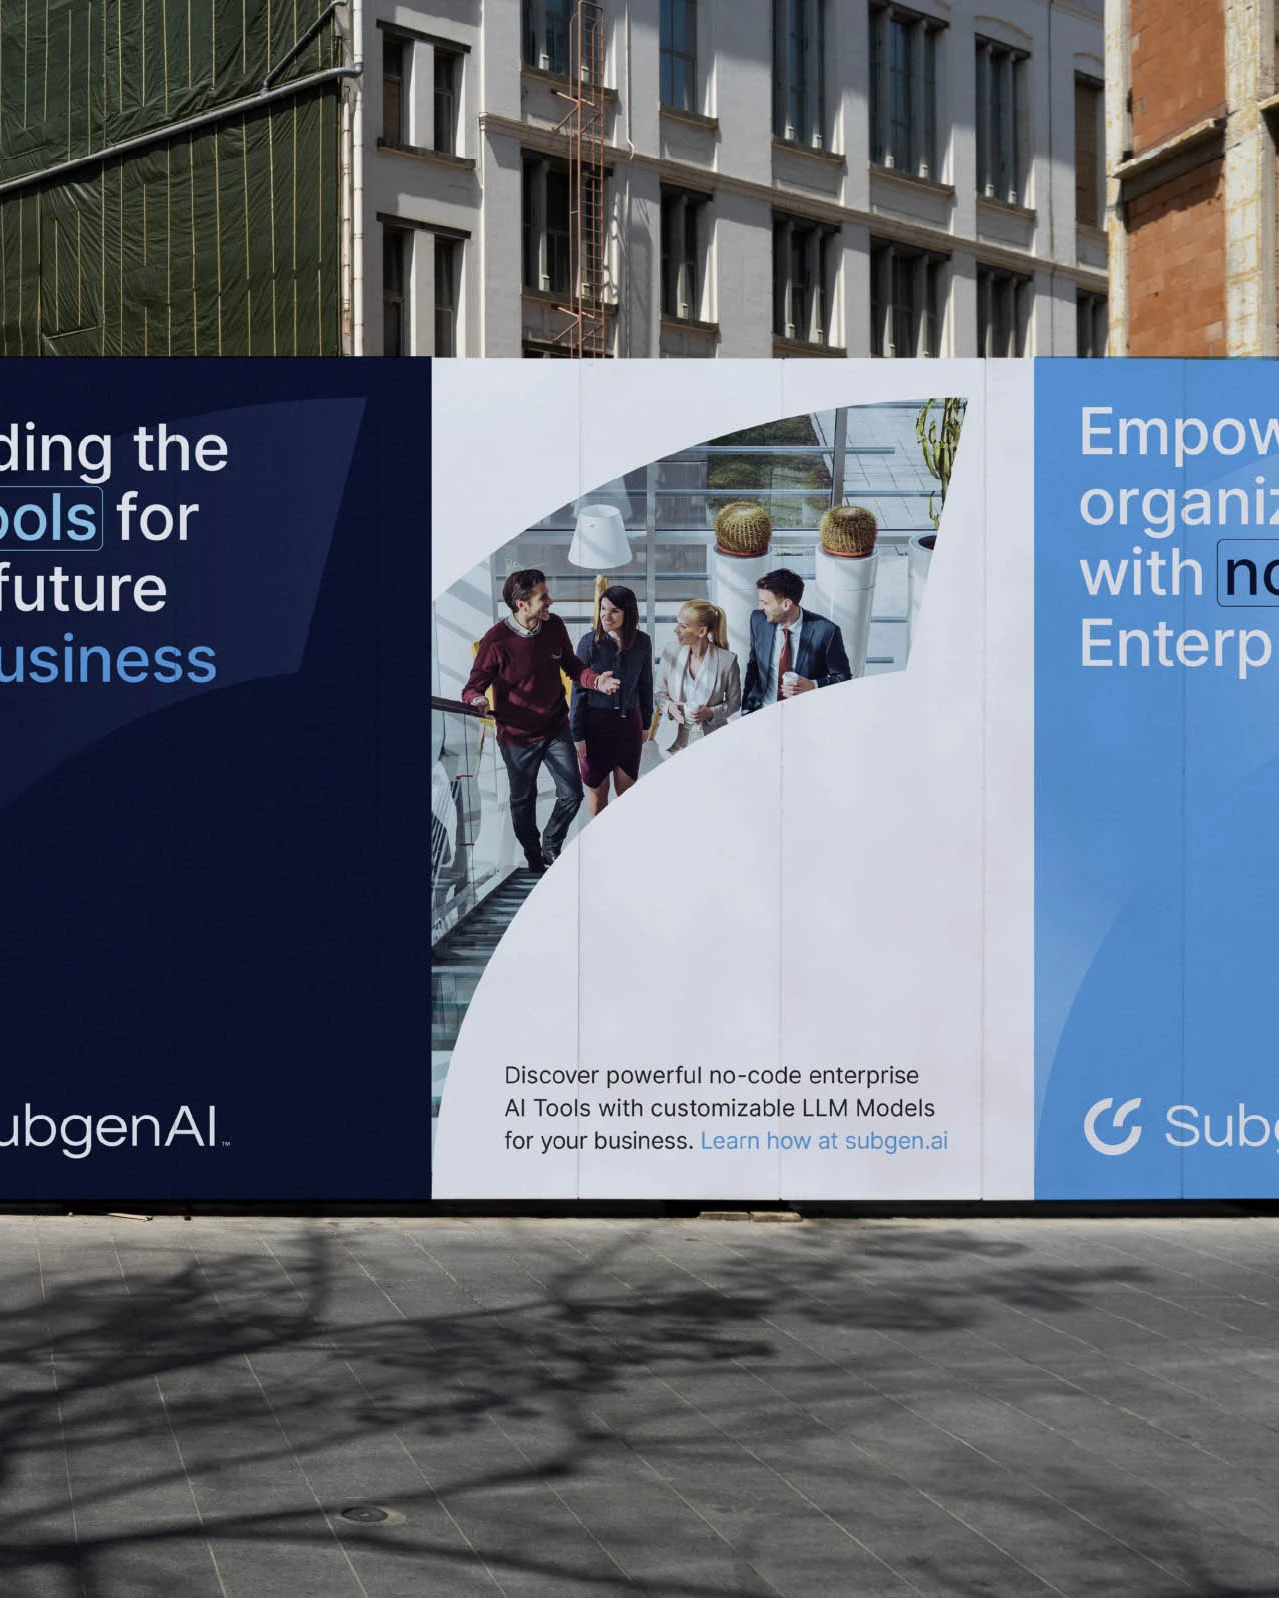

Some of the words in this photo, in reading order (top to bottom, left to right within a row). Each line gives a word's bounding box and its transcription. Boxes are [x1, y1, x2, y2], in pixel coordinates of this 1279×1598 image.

[132, 422, 228, 471] the
[116, 490, 199, 541] for
[1079, 545, 1203, 596] with
[505, 1065, 600, 1085] Discover
[606, 1065, 702, 1089] powerful
[709, 1065, 802, 1085] no-code
[809, 1065, 919, 1089] enterprise
[504, 1098, 525, 1118] AI
[533, 1097, 591, 1118] Tools
[598, 1097, 644, 1118] with
[650, 1097, 795, 1118] customizable
[803, 1098, 848, 1118] LLM
[856, 1097, 935, 1118] Models
[1165, 1102, 1279, 1156] Sub
[504, 1129, 535, 1150] for
[540, 1134, 589, 1155] your
[594, 1130, 694, 1150] business.
[701, 1131, 760, 1150] Learn
[767, 1130, 812, 1150] how
[818, 1132, 839, 1150] at
[845, 1130, 949, 1155] subgen.ai
